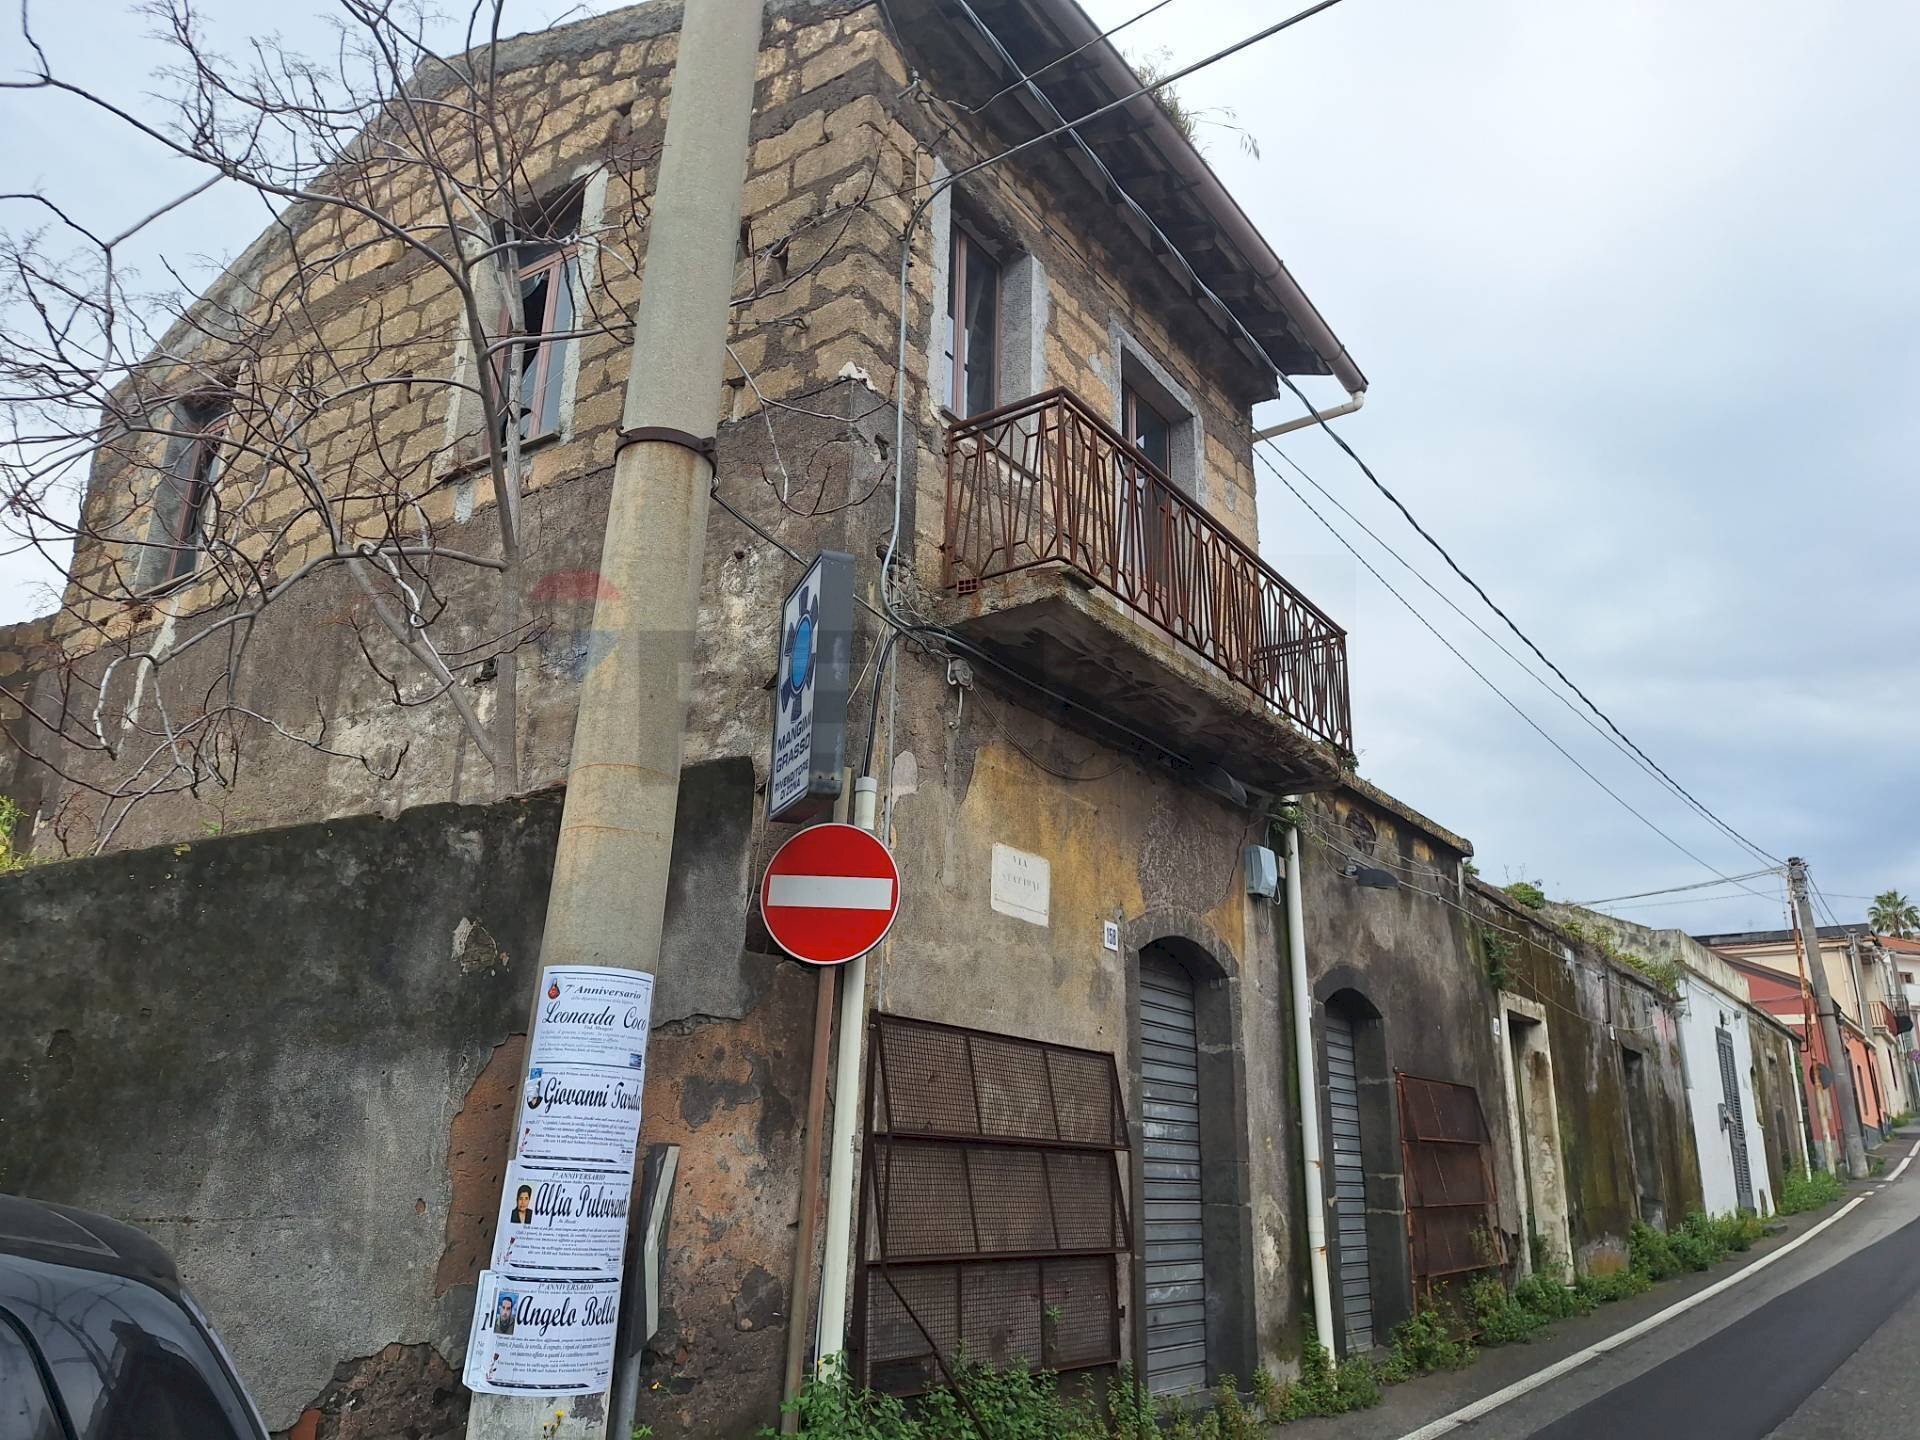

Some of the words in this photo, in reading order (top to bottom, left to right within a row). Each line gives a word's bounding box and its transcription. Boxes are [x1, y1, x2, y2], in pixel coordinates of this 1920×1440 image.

[777, 710, 812, 752] MANGIMI
[776, 732, 811, 773] GRASSO
[774, 759, 809, 793] RIVENDITORE
[1013, 855, 1028, 870] VIA
[574, 986, 642, 999] Anniversario
[542, 1000, 616, 1026] Leonarda
[623, 1006, 647, 1031] Coco
[544, 1077, 610, 1114] Giovanni
[560, 1172, 606, 1181] ANNIVERSARIO
[534, 1183, 573, 1227] Alfia
[517, 1295, 577, 1337] Angelo
[581, 1295, 616, 1326] Bella
